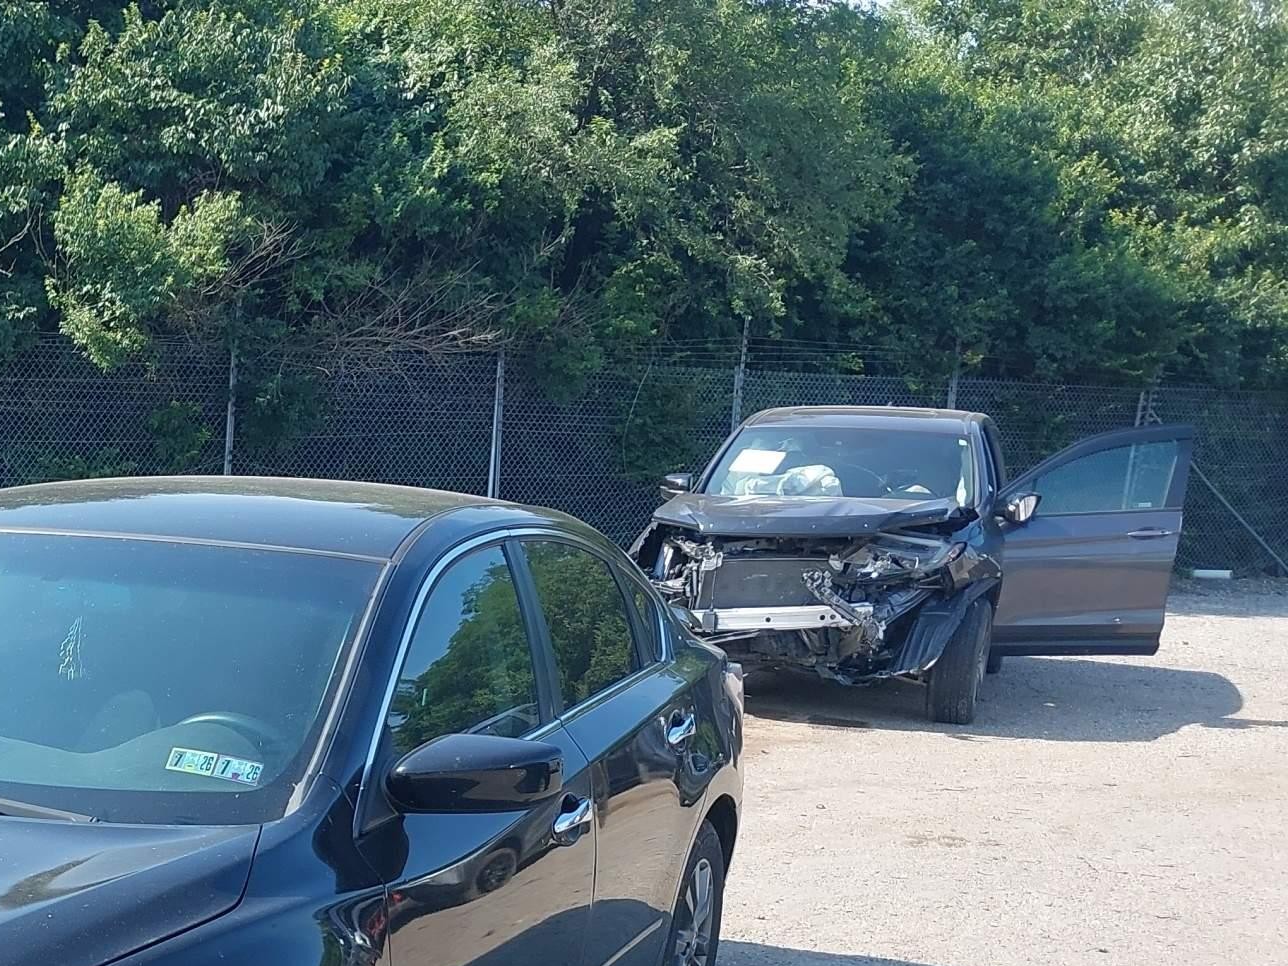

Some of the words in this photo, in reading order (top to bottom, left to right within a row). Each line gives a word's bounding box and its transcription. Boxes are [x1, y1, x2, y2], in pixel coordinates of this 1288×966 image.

[174, 753, 183, 767] 7
[199, 755, 215, 772] 26
[221, 759, 231, 775] 7
[245, 764, 261, 781] 26
